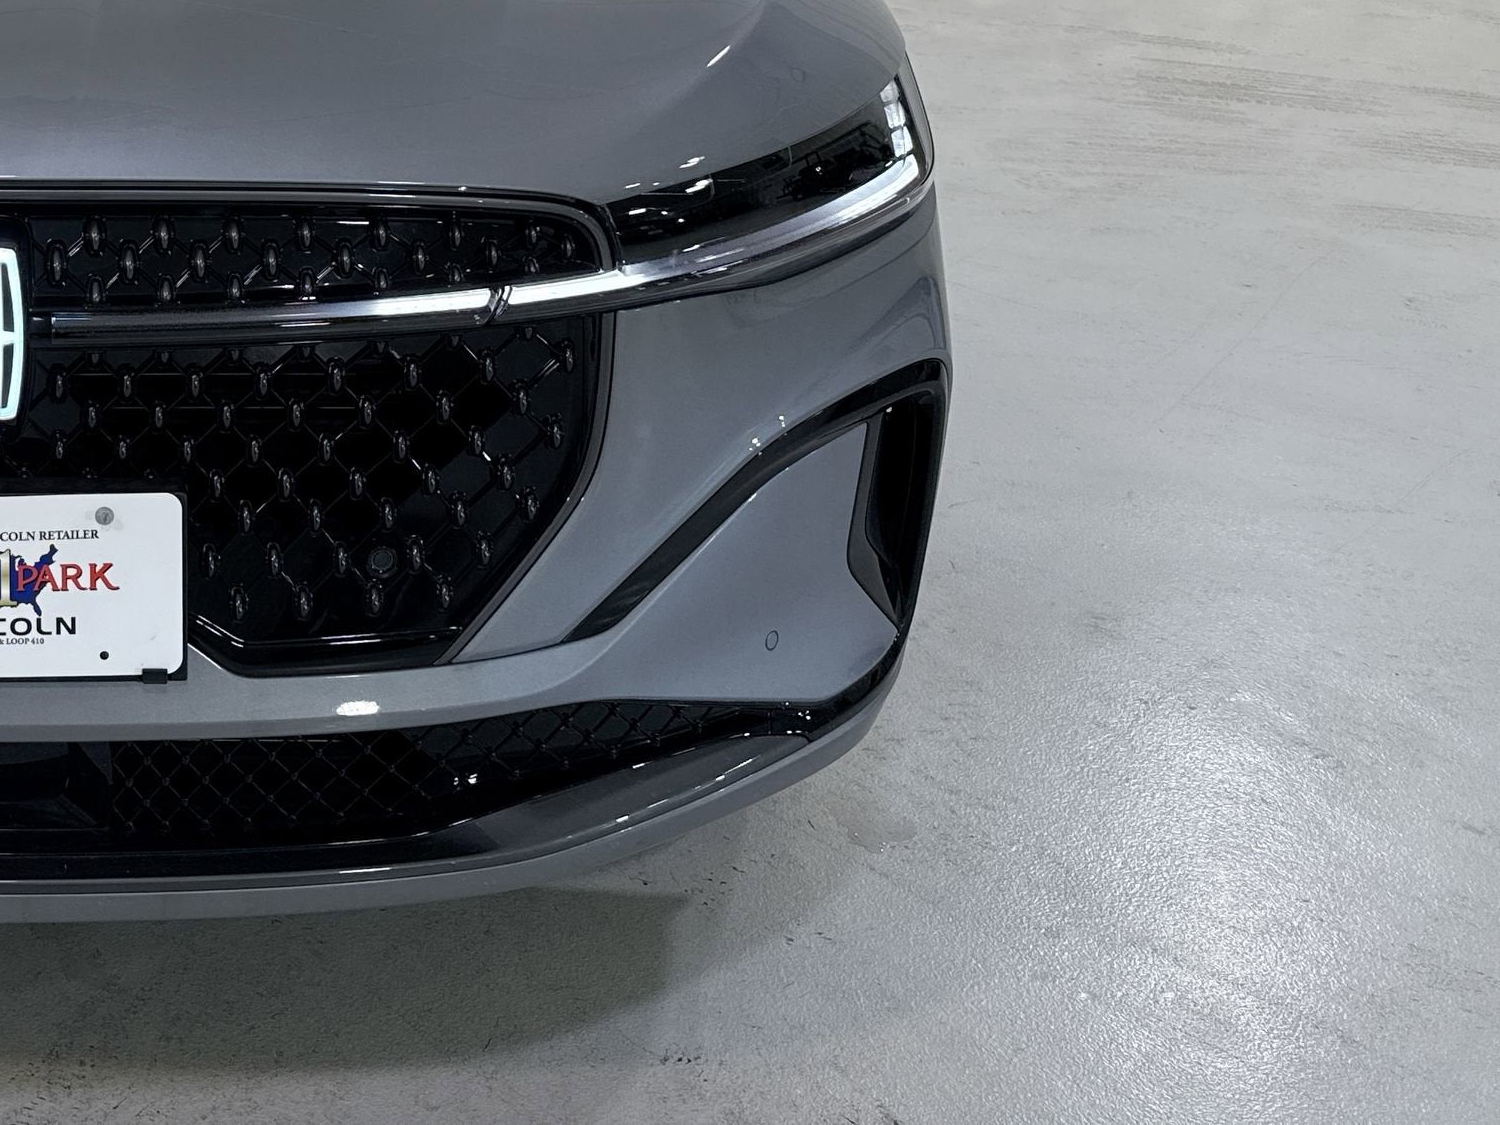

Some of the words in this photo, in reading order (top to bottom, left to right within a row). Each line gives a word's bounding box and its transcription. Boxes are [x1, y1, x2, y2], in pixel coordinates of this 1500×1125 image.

[39, 529, 100, 541] RETAILER
[16, 562, 121, 592] PARK
[5, 637, 30, 645] LOOP
[30, 637, 45, 645] 410
